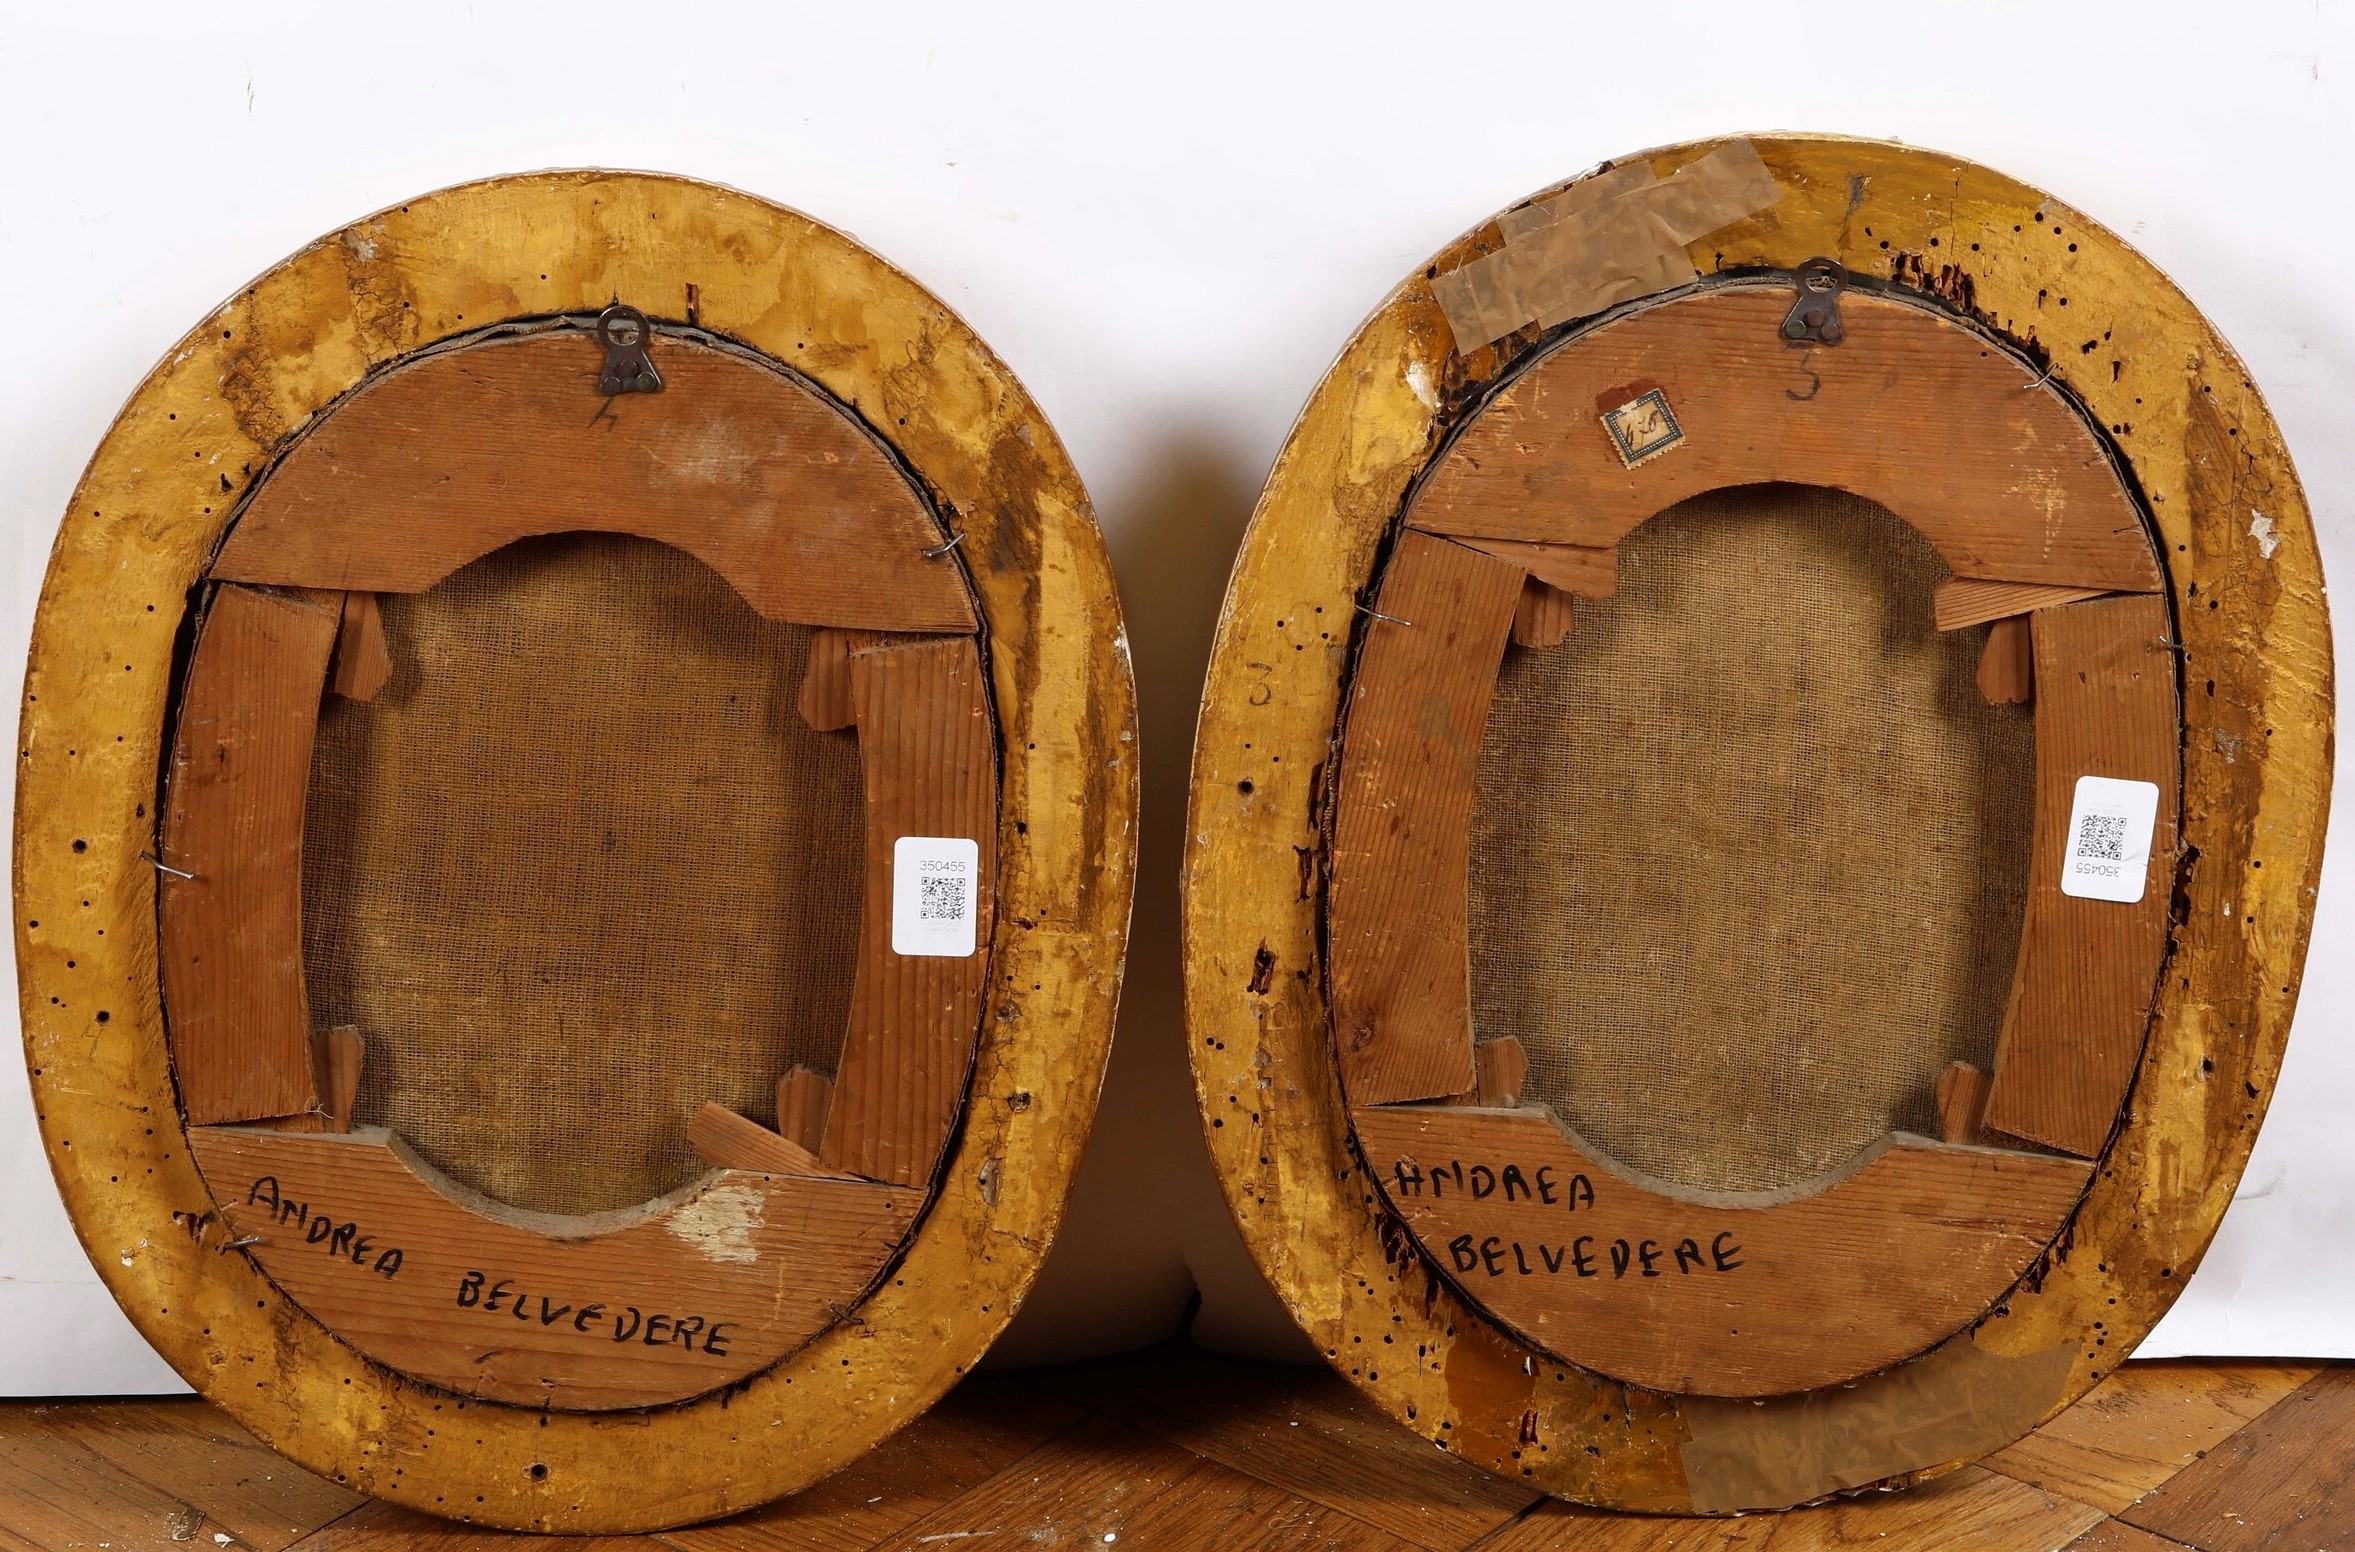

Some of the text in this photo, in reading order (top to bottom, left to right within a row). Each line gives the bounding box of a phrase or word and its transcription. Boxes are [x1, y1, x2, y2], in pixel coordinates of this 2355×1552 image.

[919, 860, 966, 872] 350455
[2075, 862, 2121, 878] 350455
[1393, 1160, 1595, 1212] ANDREA
[247, 1175, 740, 1357] ANDREA BELVEDERE
[1448, 1231, 1745, 1279] BELVEDERE
